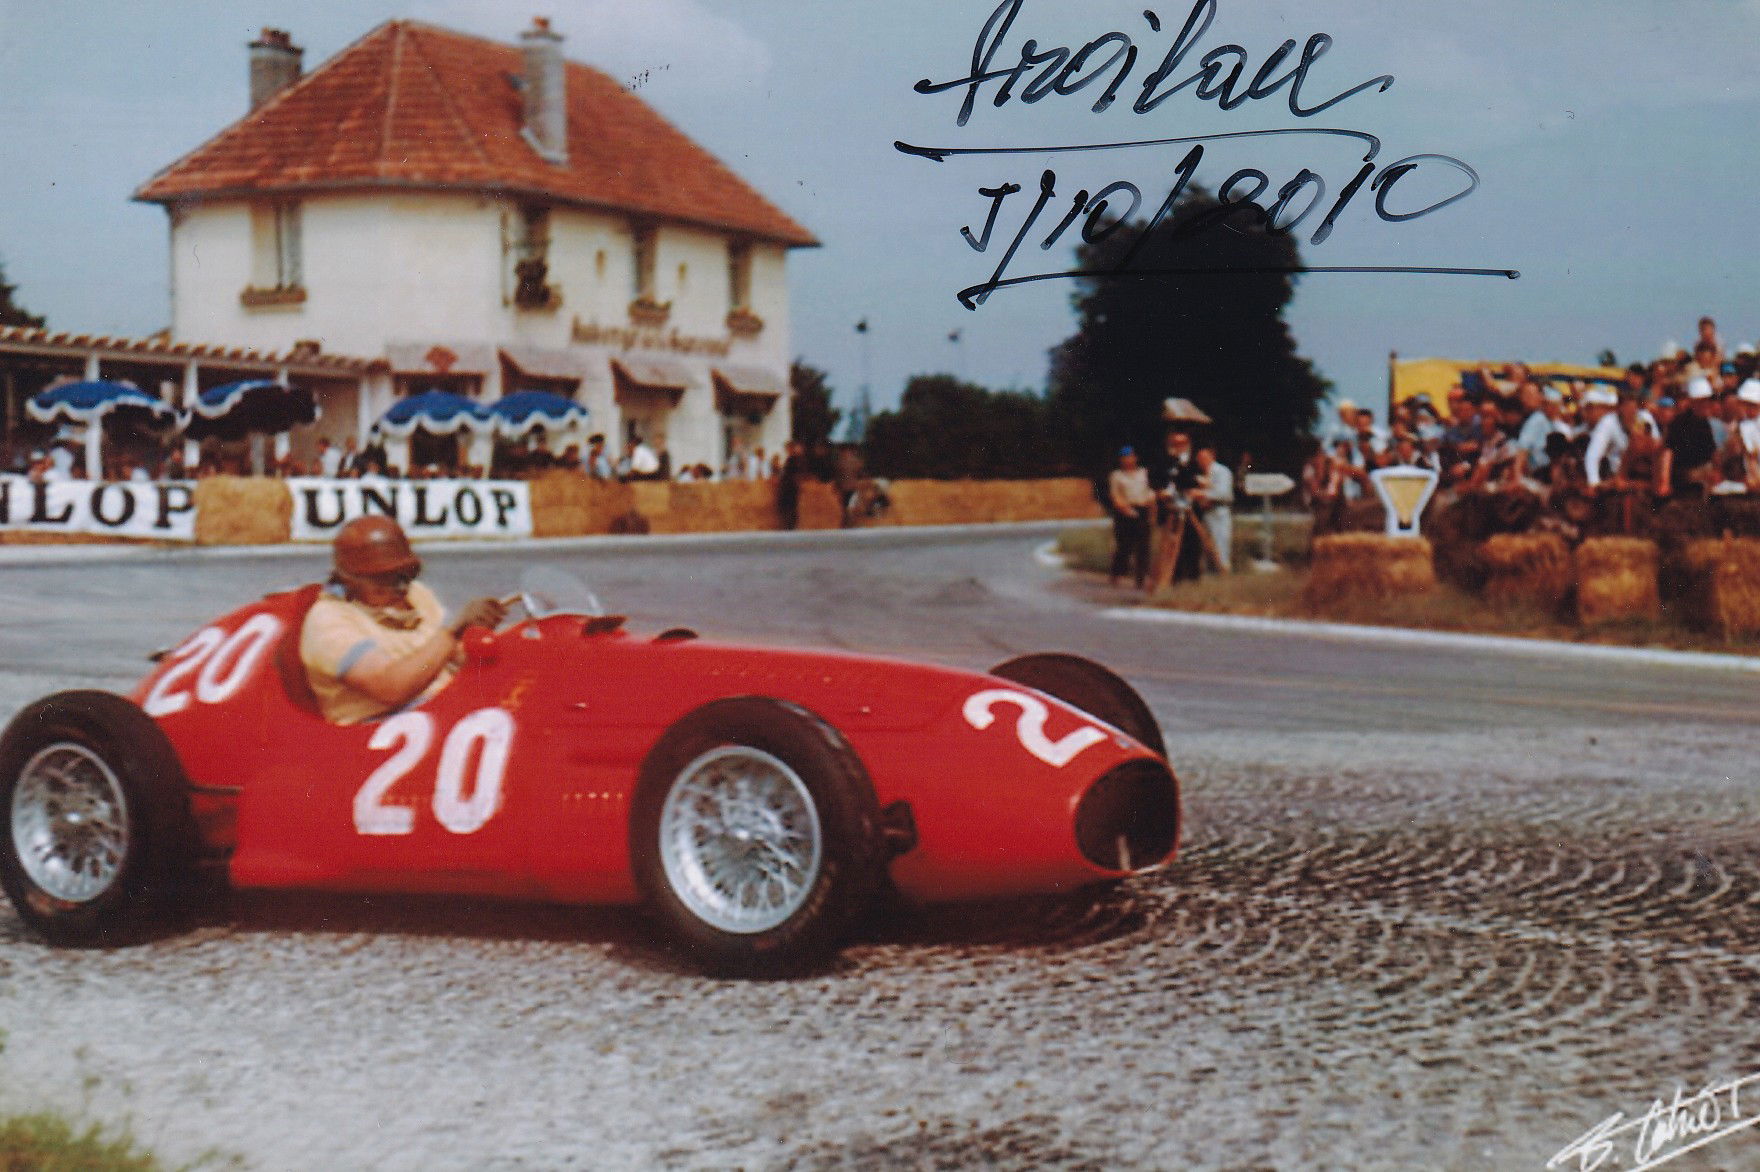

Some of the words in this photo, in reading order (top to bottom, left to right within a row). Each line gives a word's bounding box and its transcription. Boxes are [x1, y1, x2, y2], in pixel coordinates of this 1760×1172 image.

[302, 485, 517, 528] UNLOP
[143, 612, 285, 718] 20
[353, 706, 517, 834] 20
